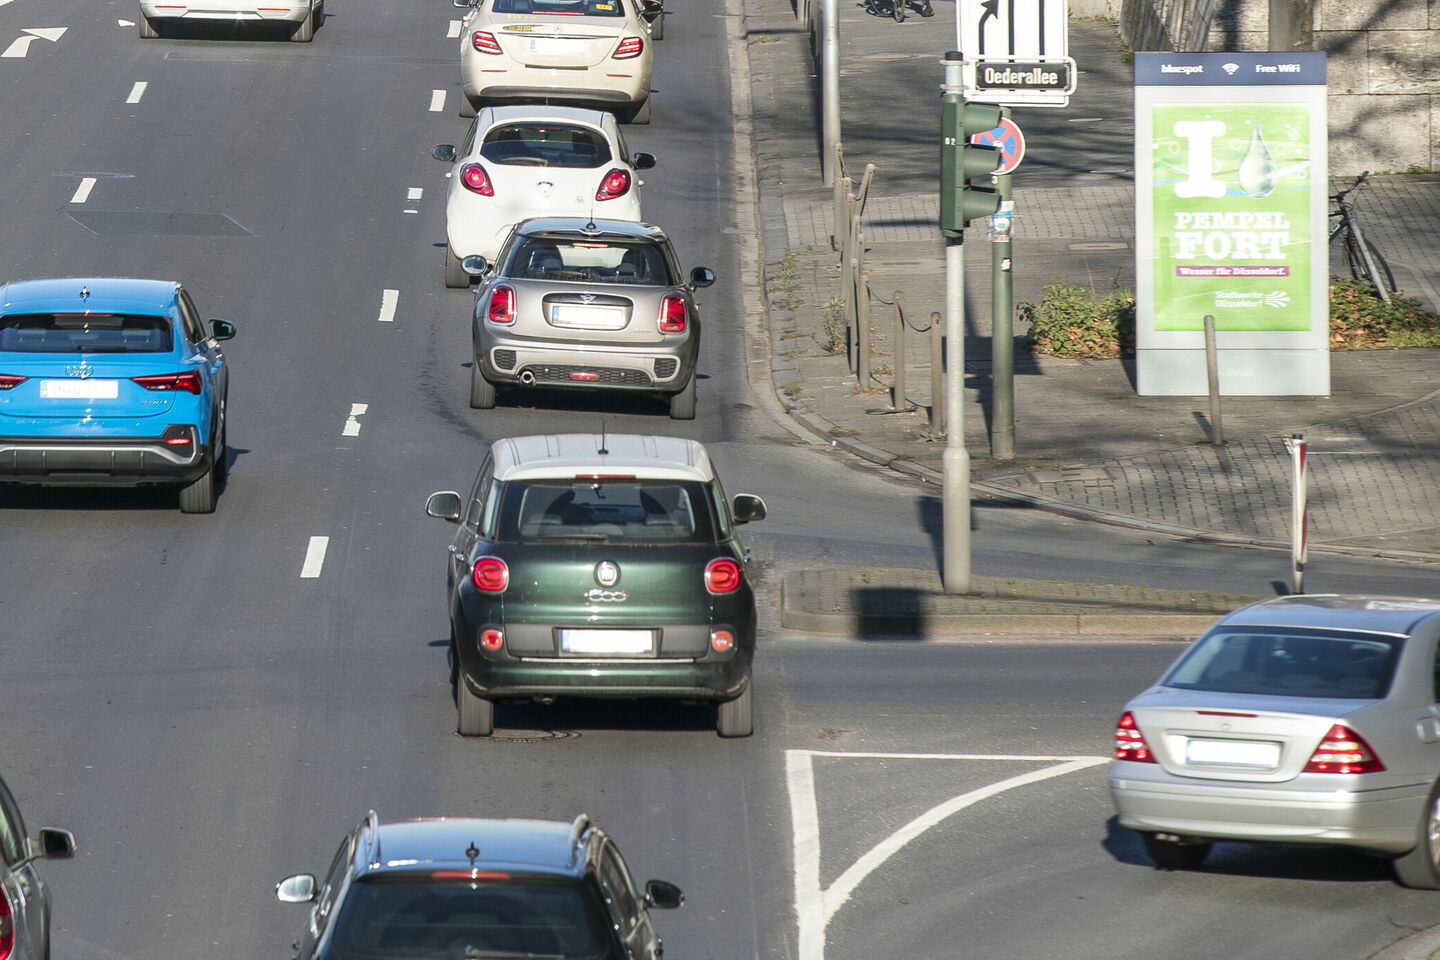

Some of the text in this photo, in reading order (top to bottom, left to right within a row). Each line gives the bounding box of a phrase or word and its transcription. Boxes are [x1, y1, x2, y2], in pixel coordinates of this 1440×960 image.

[1161, 64, 1204, 76] bluespot
[1255, 63, 1301, 74] Free WiFi
[985, 68, 1058, 85] Oederallee
[1173, 120, 1227, 199] I
[1174, 211, 1291, 230] PEMPEL
[1174, 230, 1290, 260] FORT
[1179, 266, 1287, 276] Wasser für Düsseldorf.
[1215, 291, 1264, 299] Stadtwerke
[1215, 299, 1264, 308] Düsseldorf
